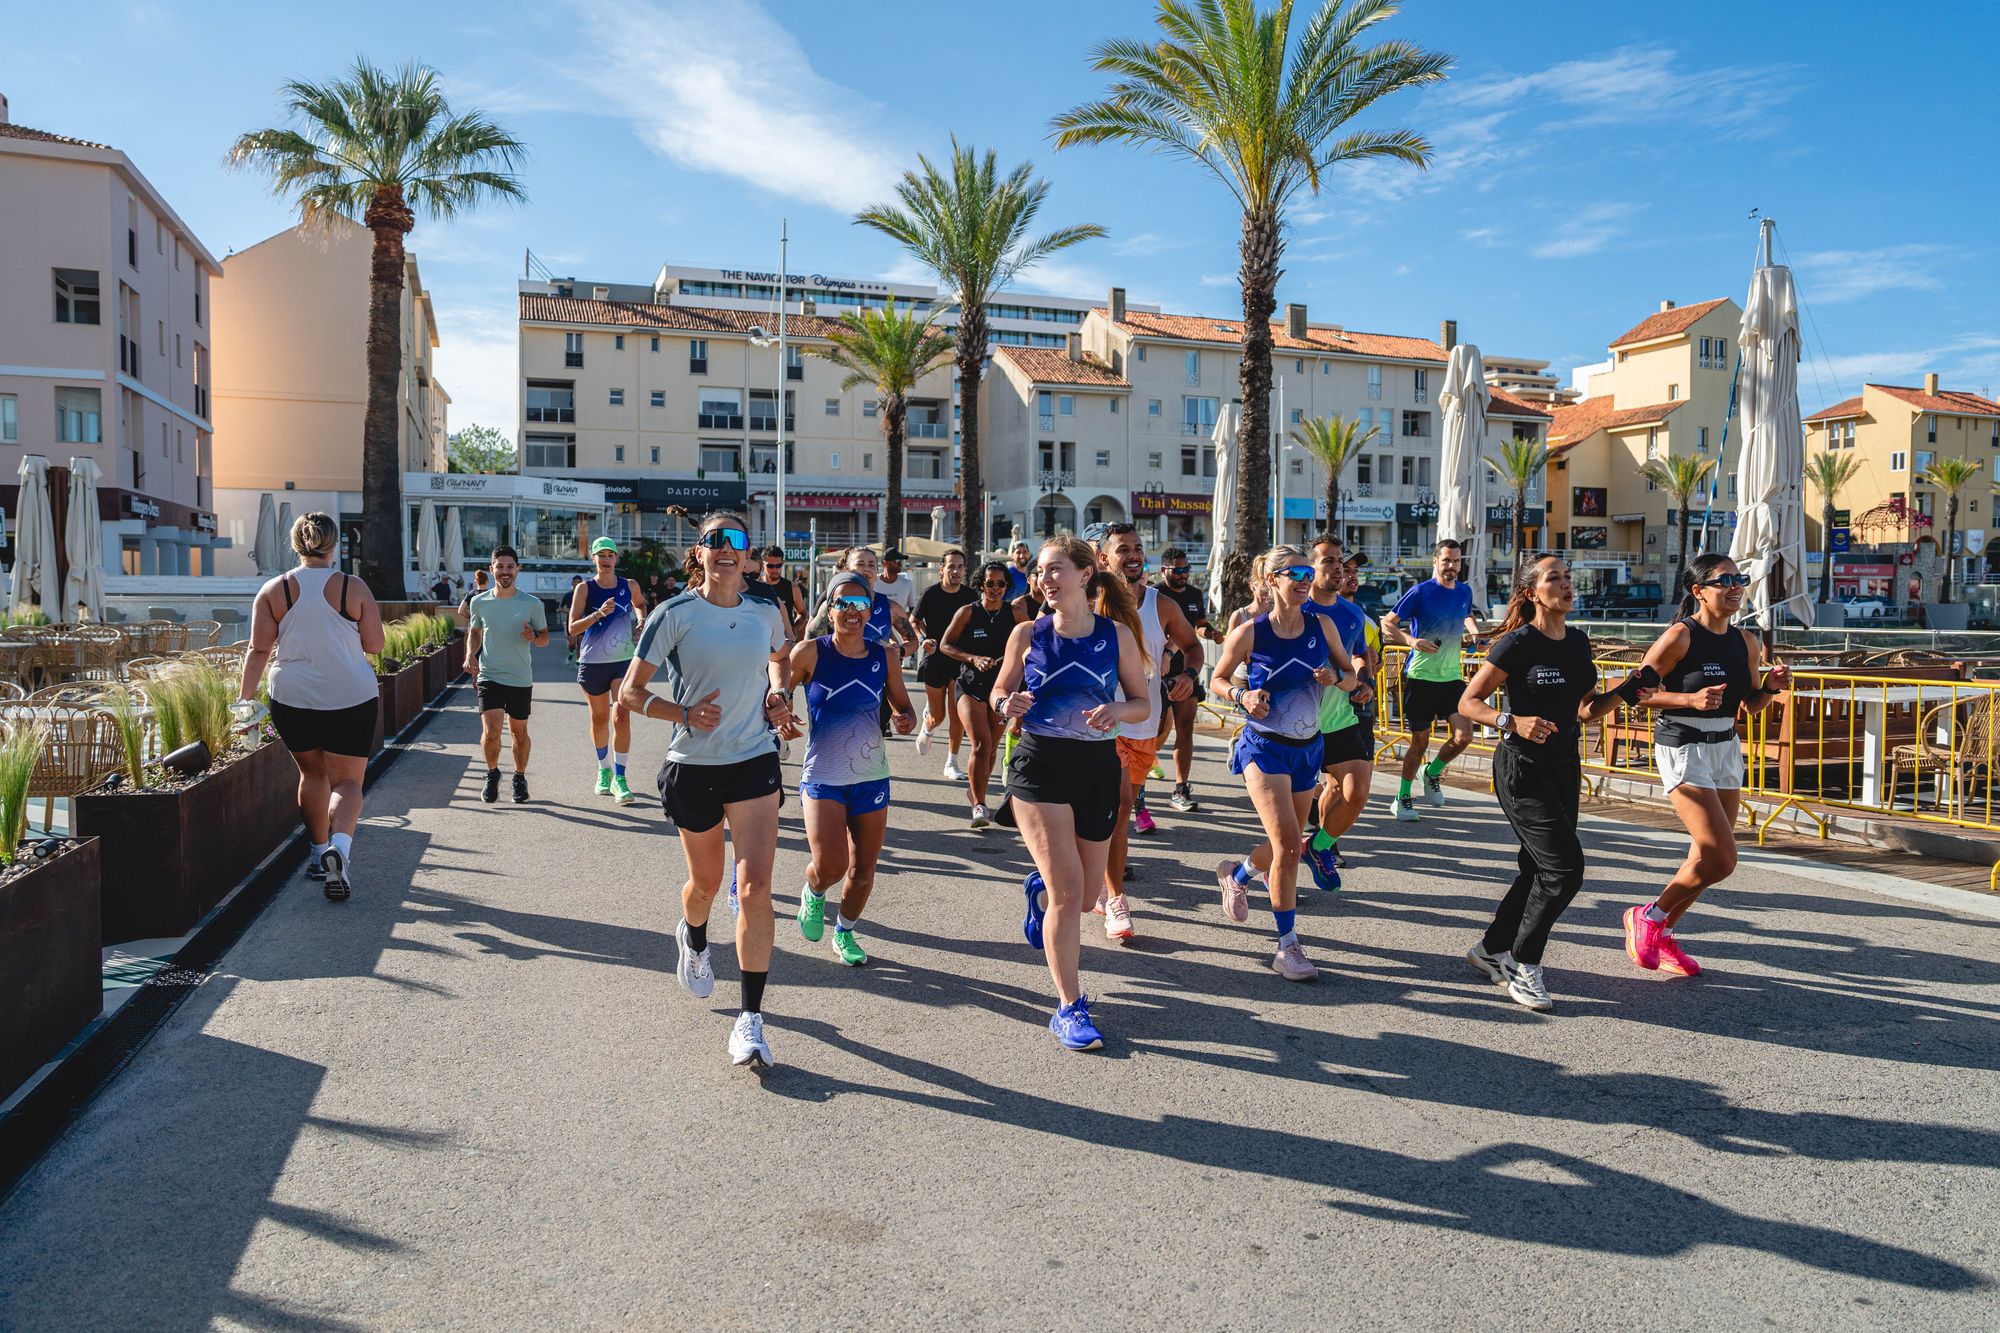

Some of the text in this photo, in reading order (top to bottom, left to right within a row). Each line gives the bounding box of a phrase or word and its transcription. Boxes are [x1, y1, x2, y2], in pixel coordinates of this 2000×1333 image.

[721, 270, 856, 290] THE NAVIGTOR Olympus
[1139, 496, 1213, 512] Thai Massag
